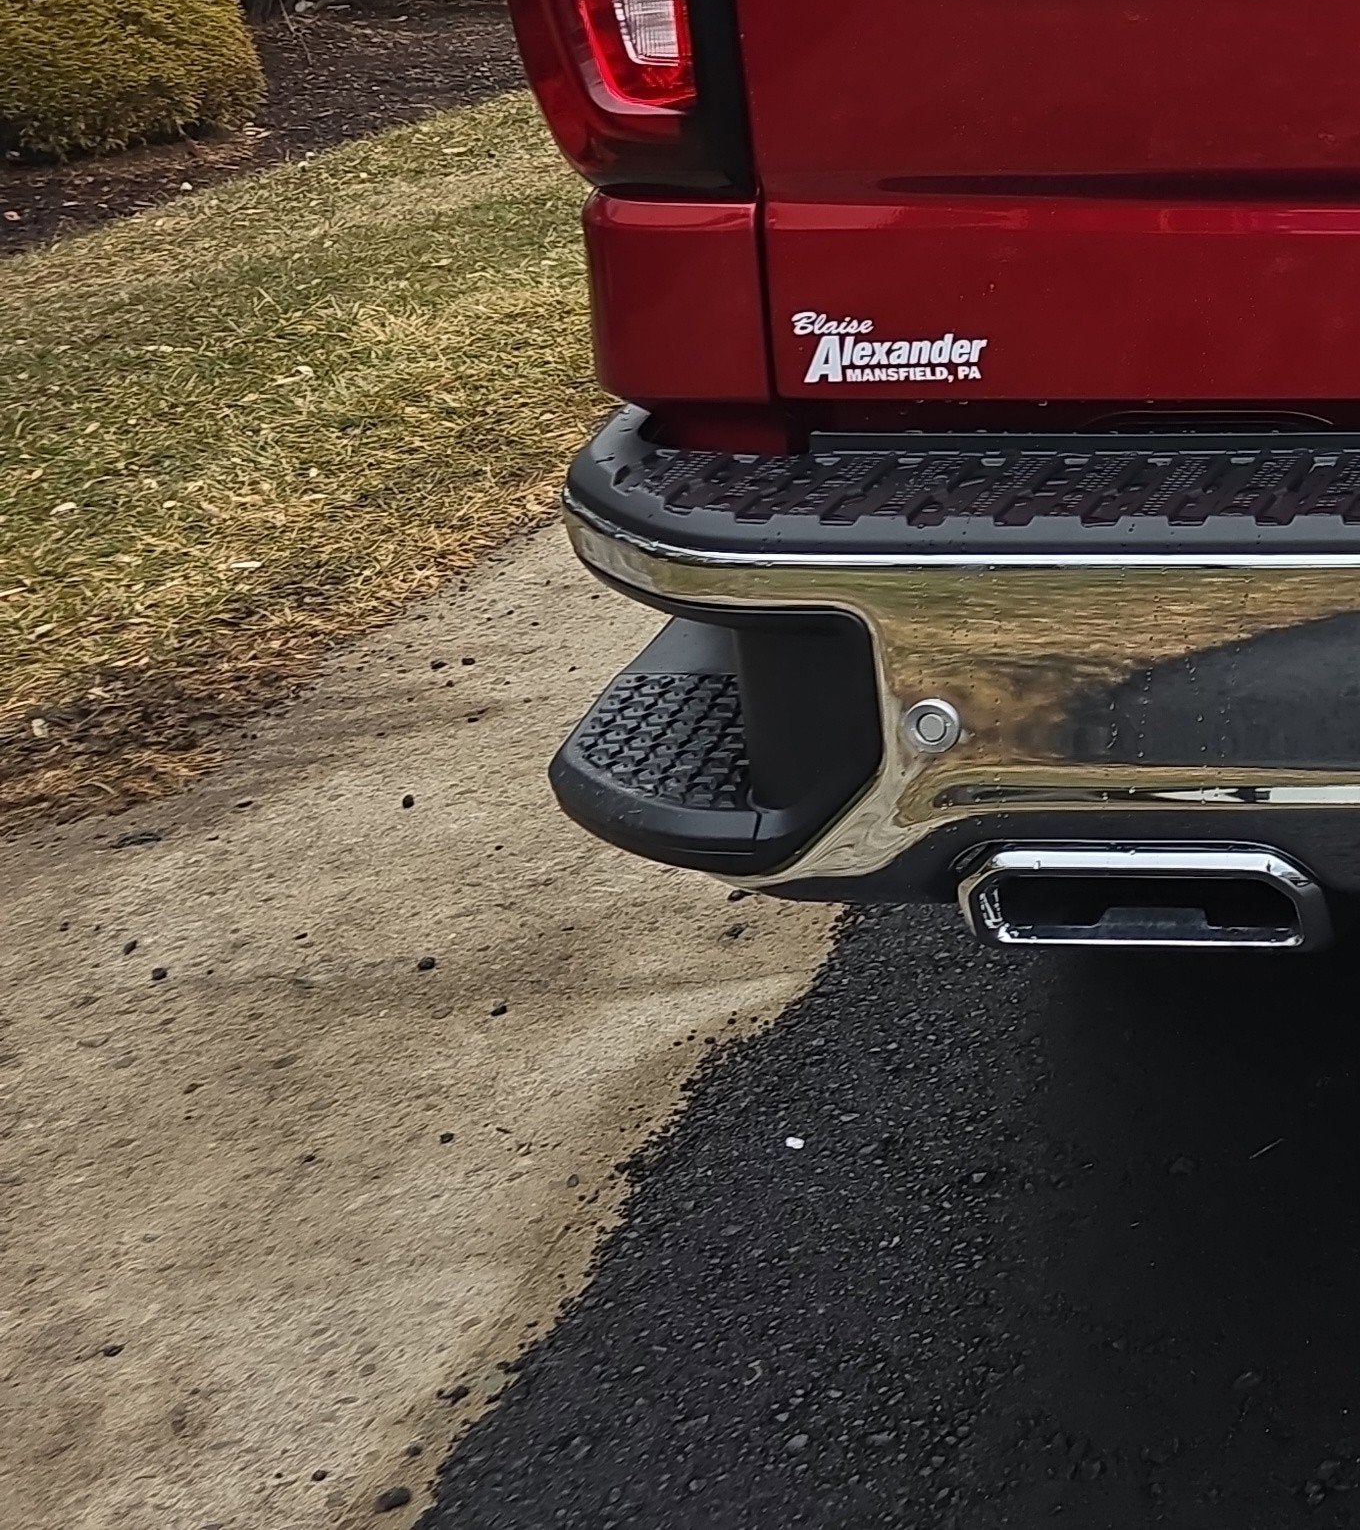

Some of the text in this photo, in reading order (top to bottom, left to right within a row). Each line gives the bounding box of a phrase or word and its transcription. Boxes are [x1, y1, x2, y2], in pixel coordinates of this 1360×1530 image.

[791, 311, 874, 335] Blaise
[803, 332, 988, 383] Alexander
[845, 365, 982, 383] MANSFIELD, PA
